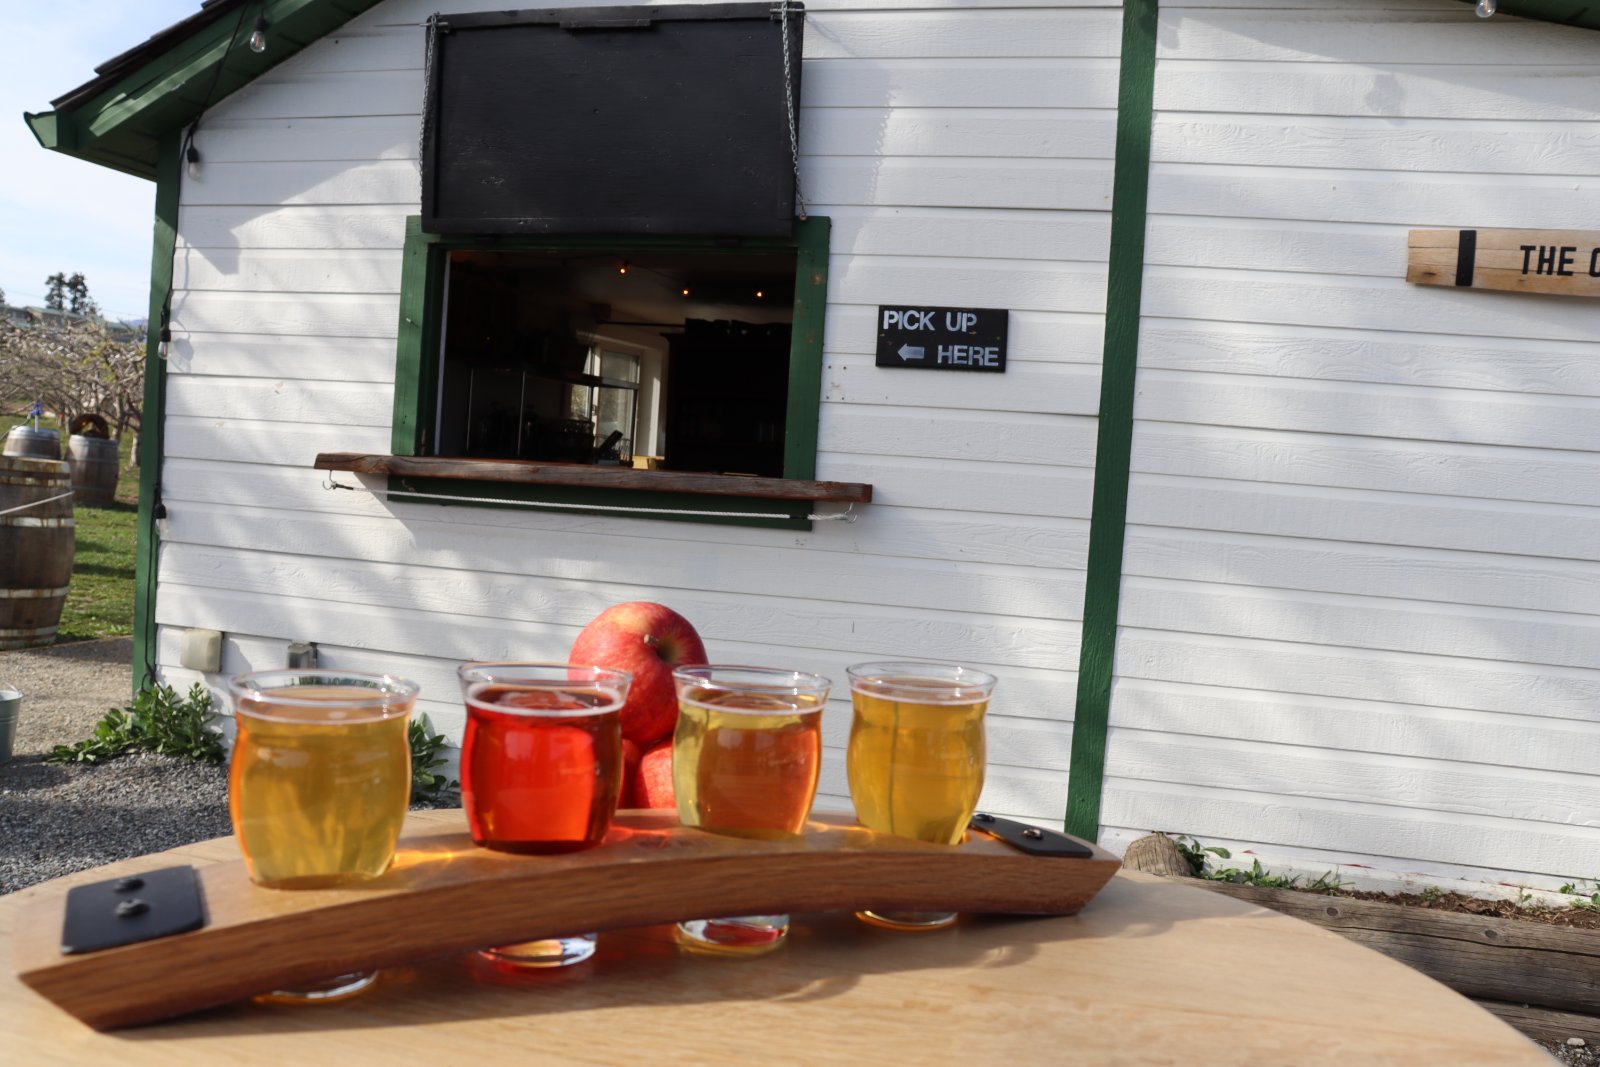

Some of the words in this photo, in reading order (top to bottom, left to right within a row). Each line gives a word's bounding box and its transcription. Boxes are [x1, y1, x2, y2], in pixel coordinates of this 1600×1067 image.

[1520, 245, 1577, 276] THE
[883, 310, 936, 331] PICK
[945, 311, 977, 332] UP
[937, 345, 999, 366] HERE
